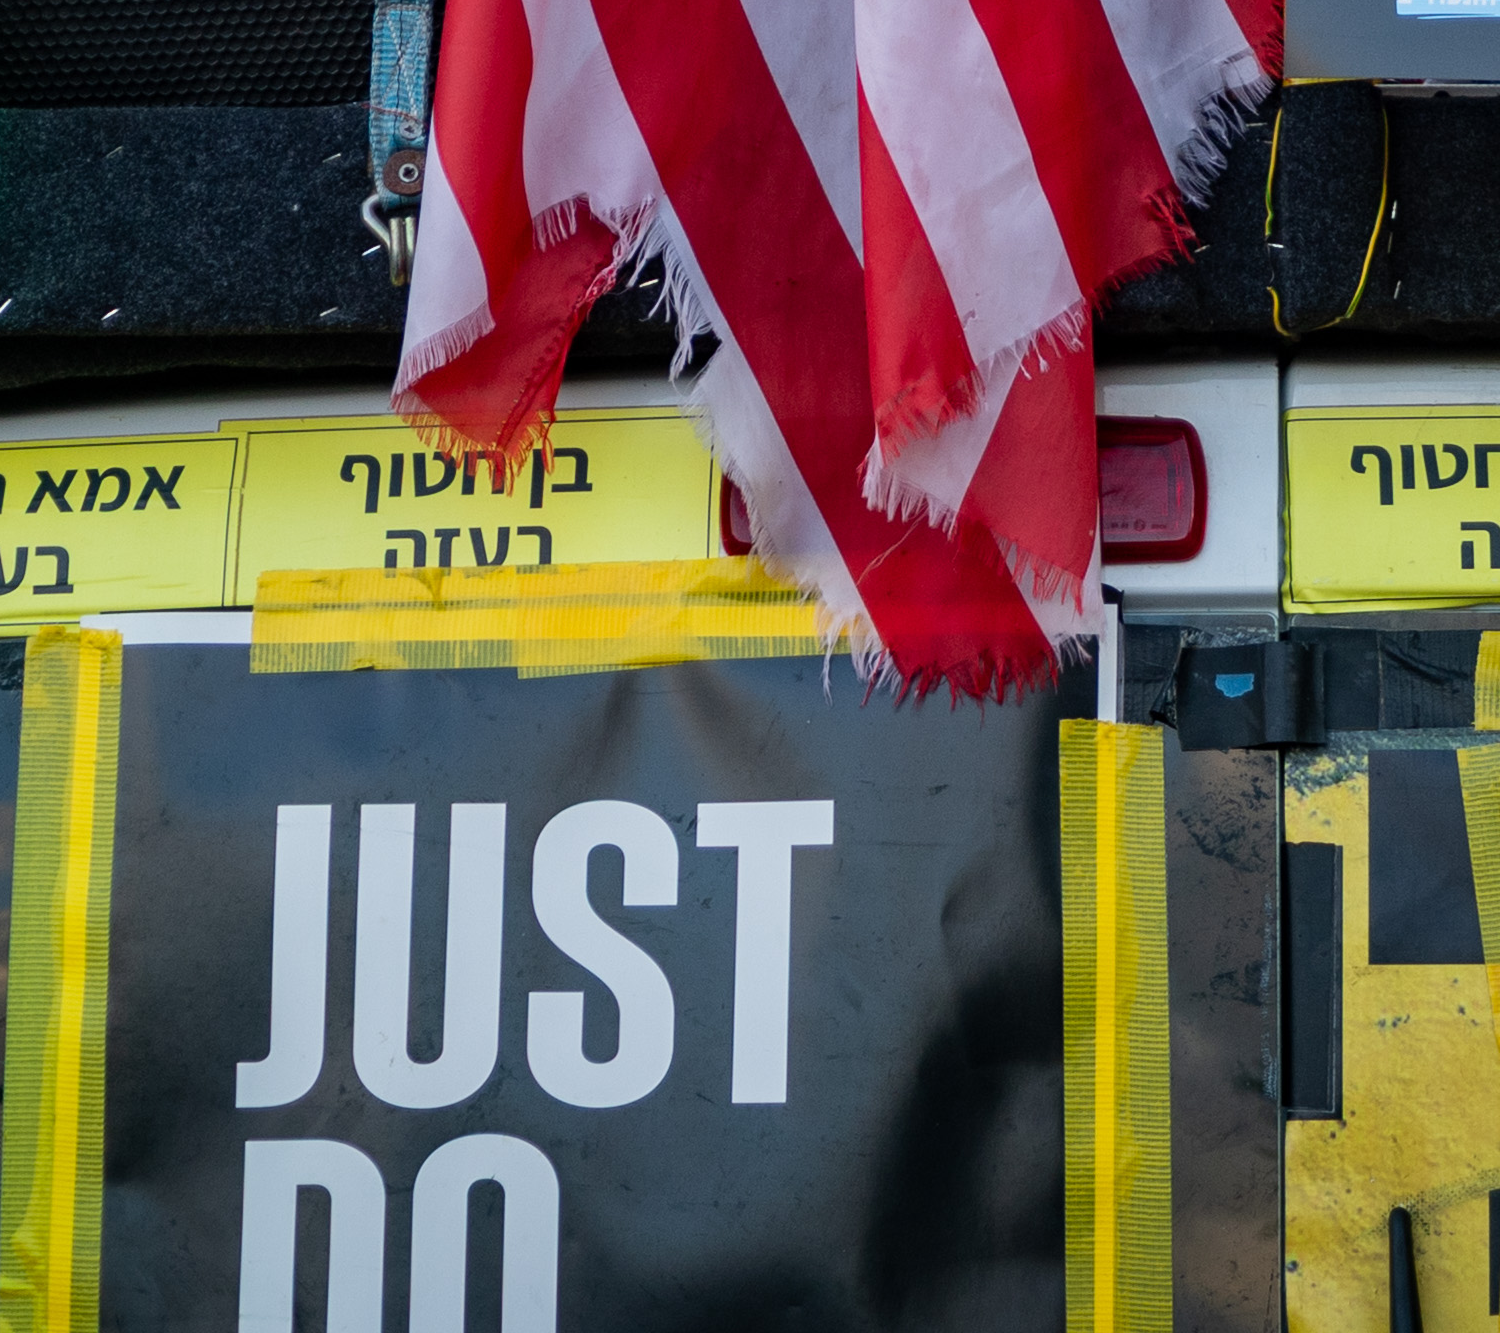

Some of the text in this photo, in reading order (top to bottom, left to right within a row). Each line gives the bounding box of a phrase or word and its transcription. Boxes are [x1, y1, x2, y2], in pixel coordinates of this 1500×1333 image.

[26, 465, 186, 514] אמא
[339, 446, 593, 514] בן חטוף
[235, 799, 835, 1109] JUST
[238, 1133, 562, 1333] DO
